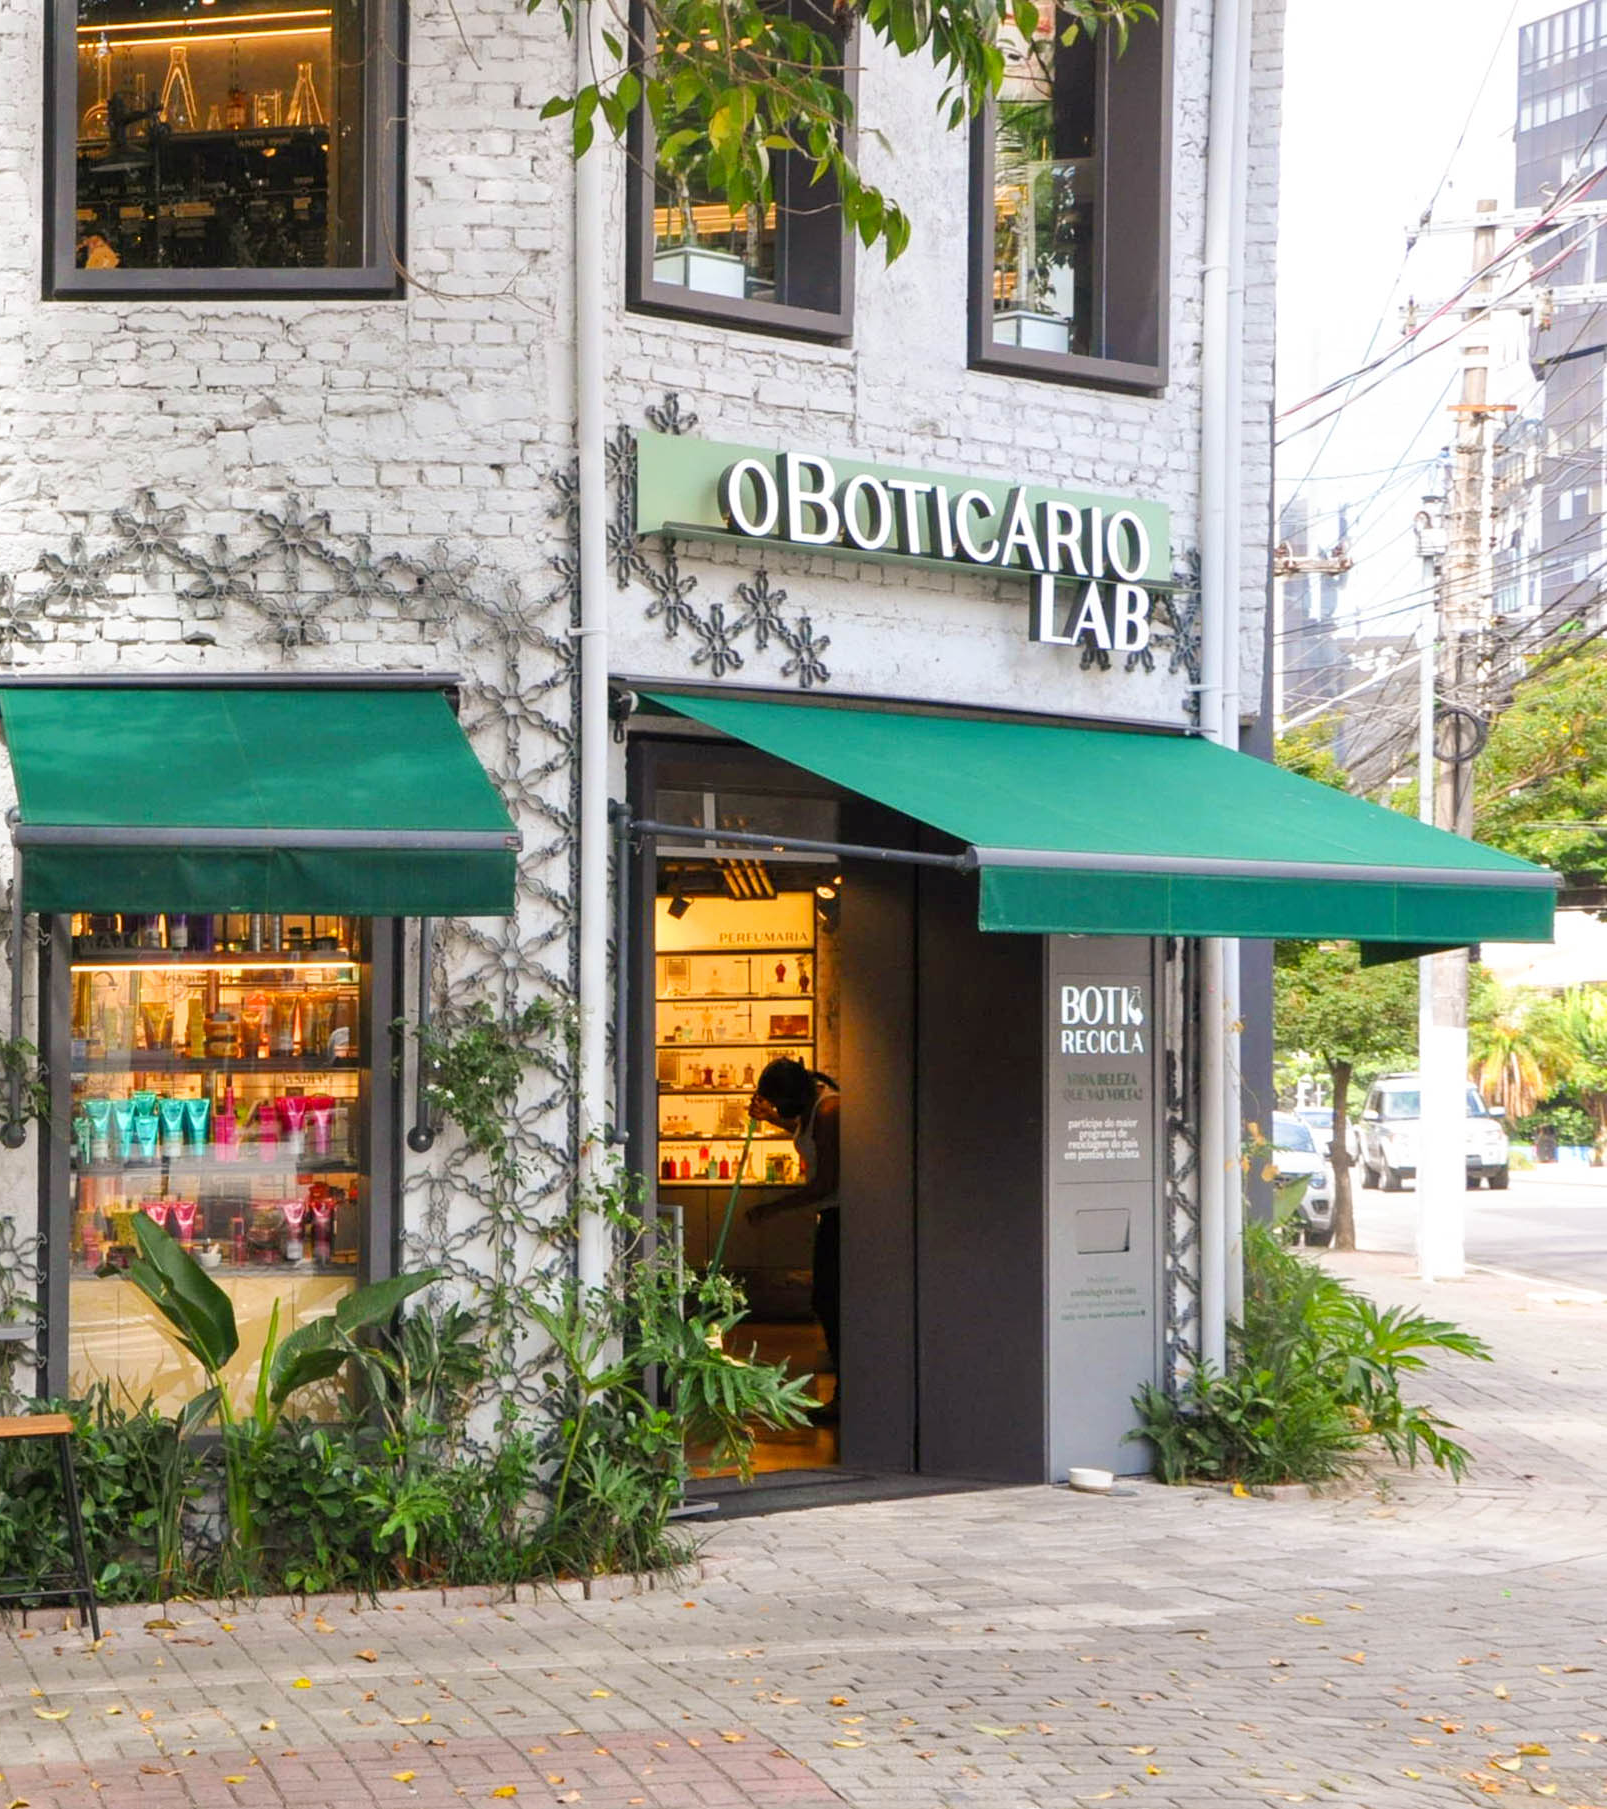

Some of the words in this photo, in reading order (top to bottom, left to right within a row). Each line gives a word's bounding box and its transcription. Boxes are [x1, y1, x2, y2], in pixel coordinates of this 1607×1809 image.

[1035, 574, 1151, 653] LAB
[719, 931, 809, 944] PERFUMARIA
[1061, 1030, 1144, 1054] RECICLA
[1096, 1072, 1138, 1086] BELEZA
